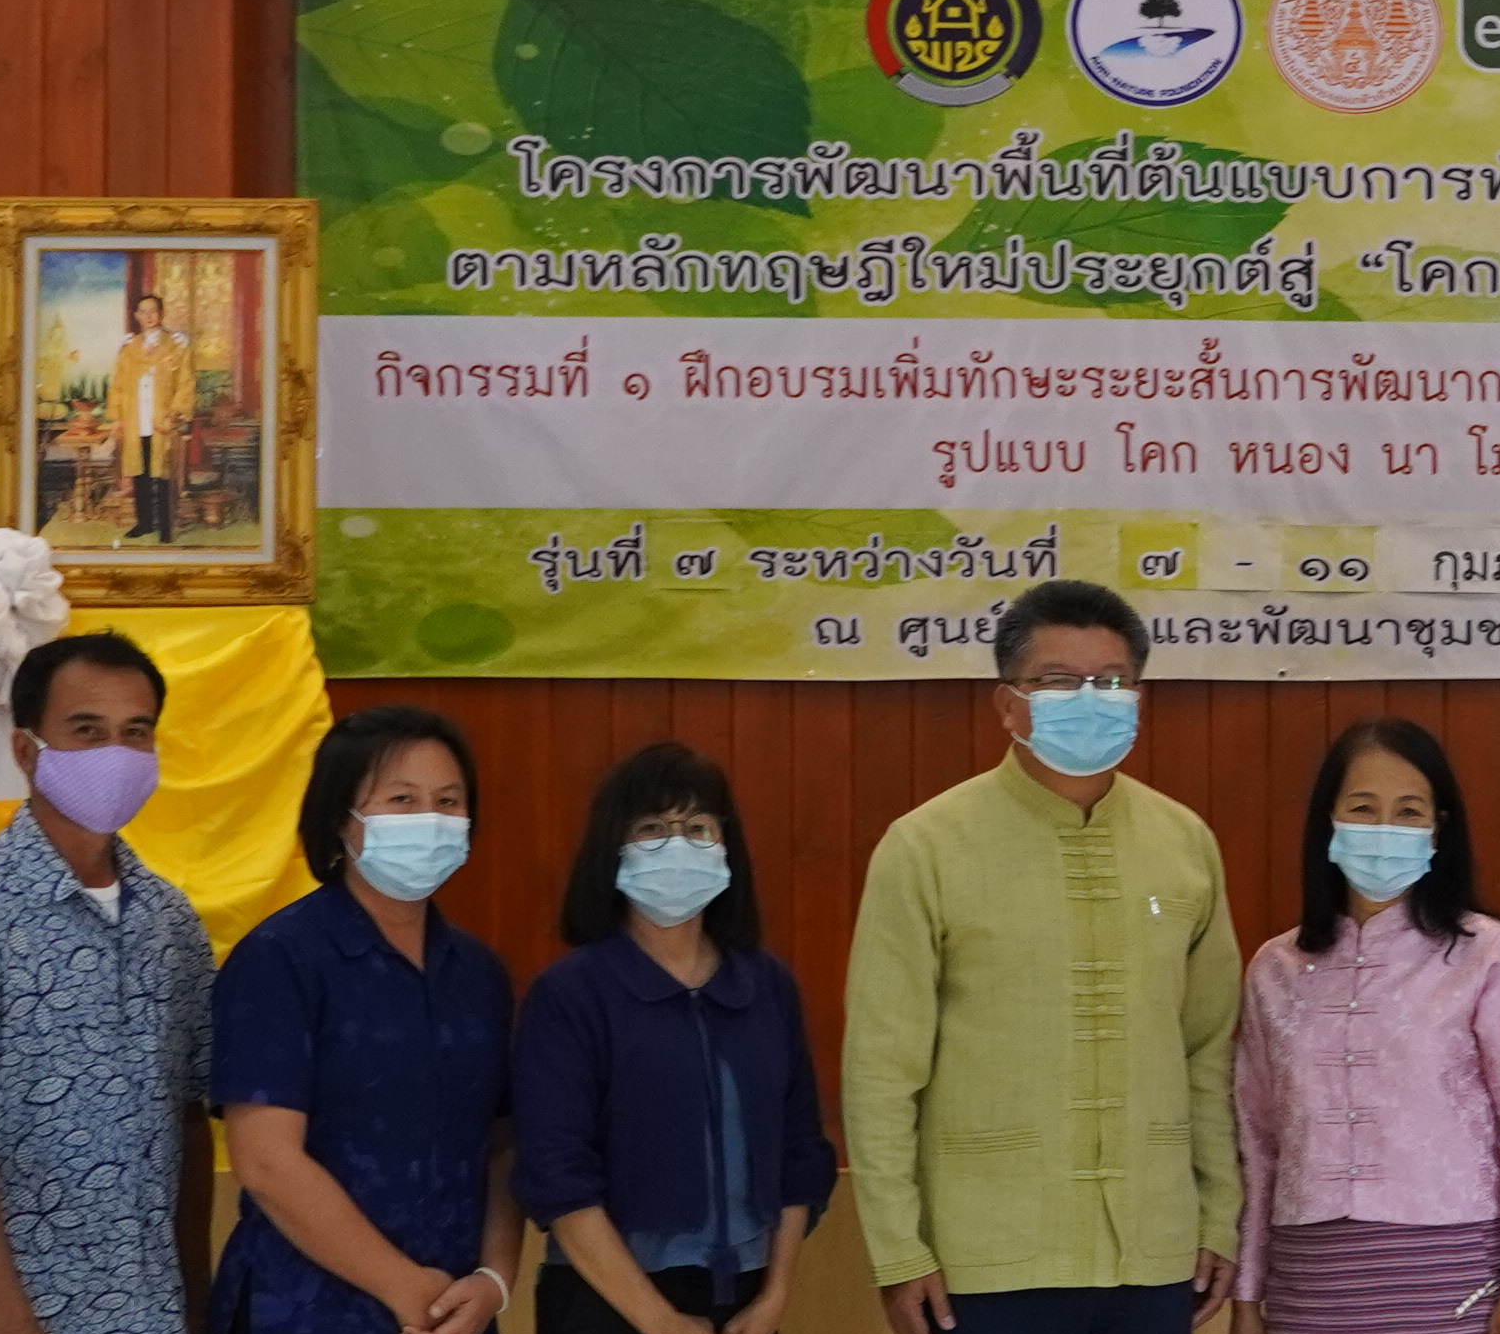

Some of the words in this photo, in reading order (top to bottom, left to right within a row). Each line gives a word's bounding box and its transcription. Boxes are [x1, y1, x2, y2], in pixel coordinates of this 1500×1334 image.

[448, 234, 1318, 310] ตามหลักทฤษฎีใหม่ประยุกต์สู่
[1359, 238, 1500, 296] “โคก
[374, 334, 590, 399] กิจกรรมที่
[622, 371, 651, 401] ๑
[931, 429, 1086, 490] รูปแบบ
[1114, 419, 1198, 475] โคก
[1228, 439, 1351, 476] หนอง
[1380, 440, 1439, 477] นา
[530, 523, 646, 593] รุ่นที่
[672, 544, 718, 580] ๗
[747, 523, 1060, 581] ระหว่างวันที่
[1136, 545, 1183, 581] ๗
[1298, 554, 1371, 584] ๑๑
[814, 610, 862, 647] ณ
